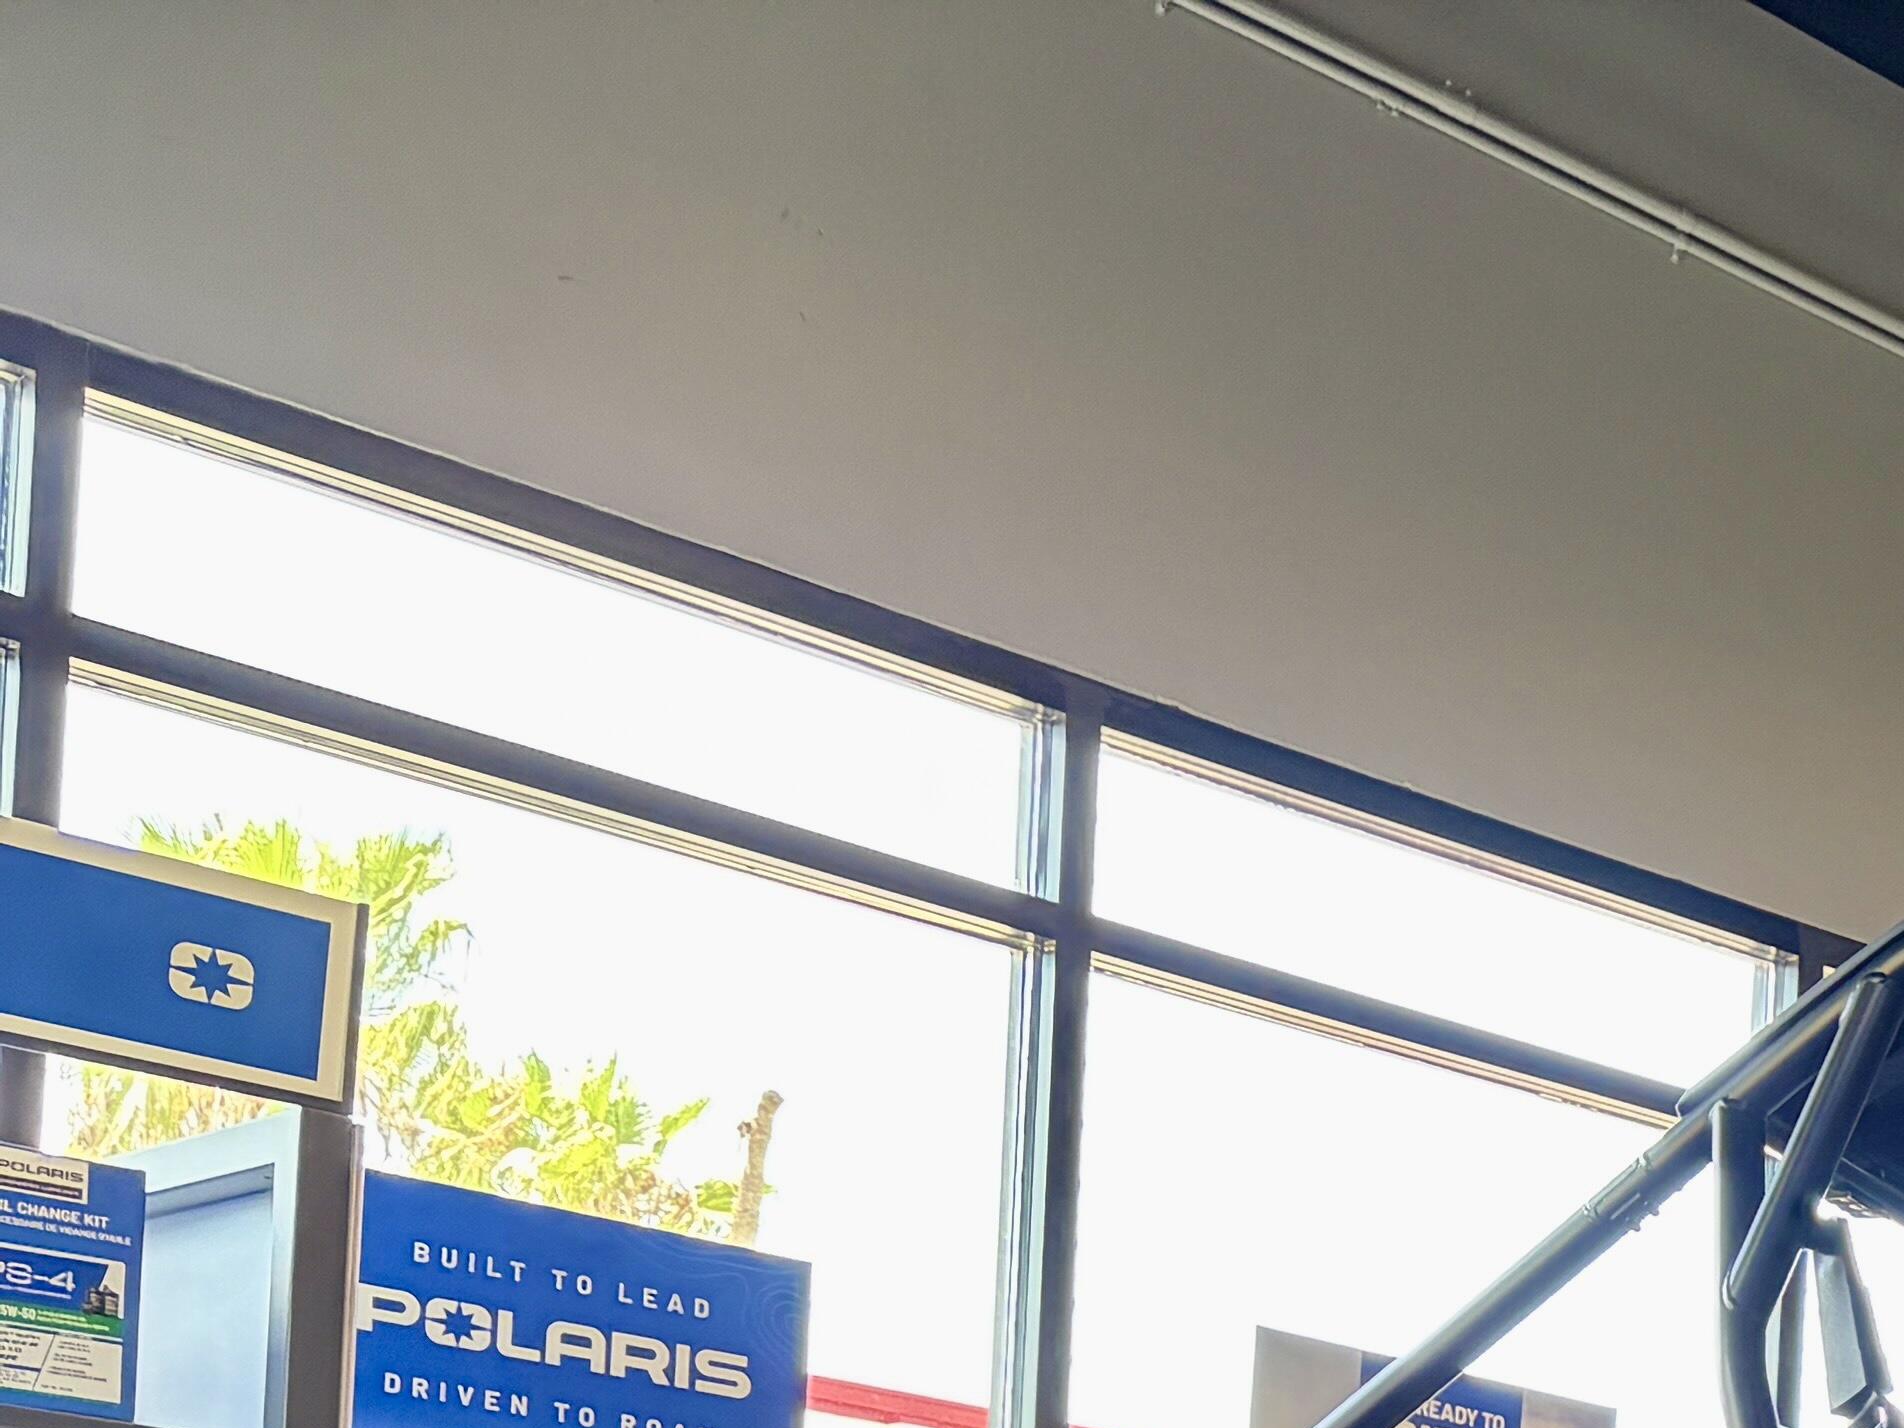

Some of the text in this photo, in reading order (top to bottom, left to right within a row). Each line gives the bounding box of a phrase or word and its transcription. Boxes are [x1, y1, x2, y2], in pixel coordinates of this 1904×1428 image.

[0, 1199, 110, 1230] IL CHANGE KIT
[0, 1261, 76, 1292] S-4
[413, 1241, 711, 1320] BUILT TO LEAD
[355, 1281, 753, 1400] POLARIS
[383, 1371, 530, 1418] DRIVEN
[553, 1402, 596, 1428] TO
